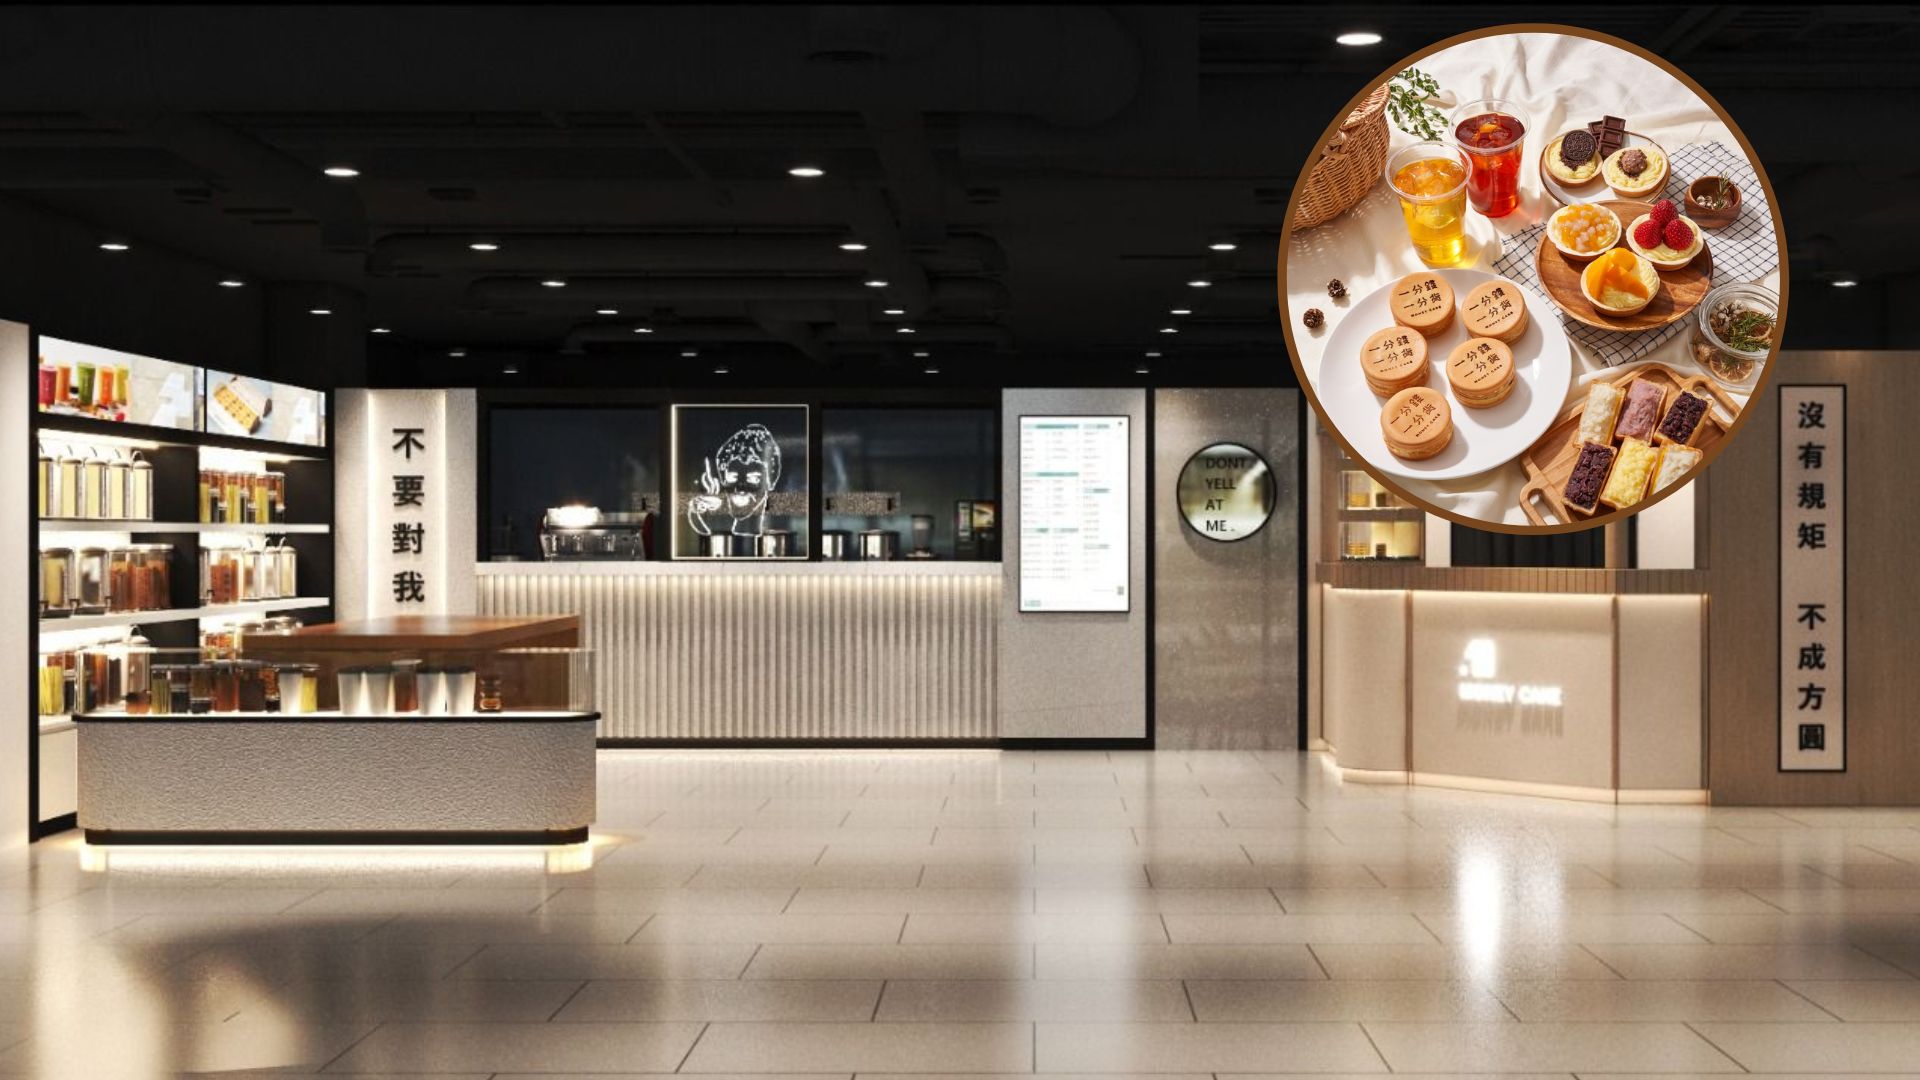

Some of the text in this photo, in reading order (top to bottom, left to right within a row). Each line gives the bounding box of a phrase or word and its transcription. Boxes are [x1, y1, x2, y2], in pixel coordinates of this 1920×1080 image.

[1206, 457, 1246, 470] DONT
[1205, 477, 1236, 490] YELL
[1205, 499, 1223, 511] AT
[392, 428, 425, 603] 不要對我
[1798, 402, 1826, 751] 沒有規矩 不成方圓
